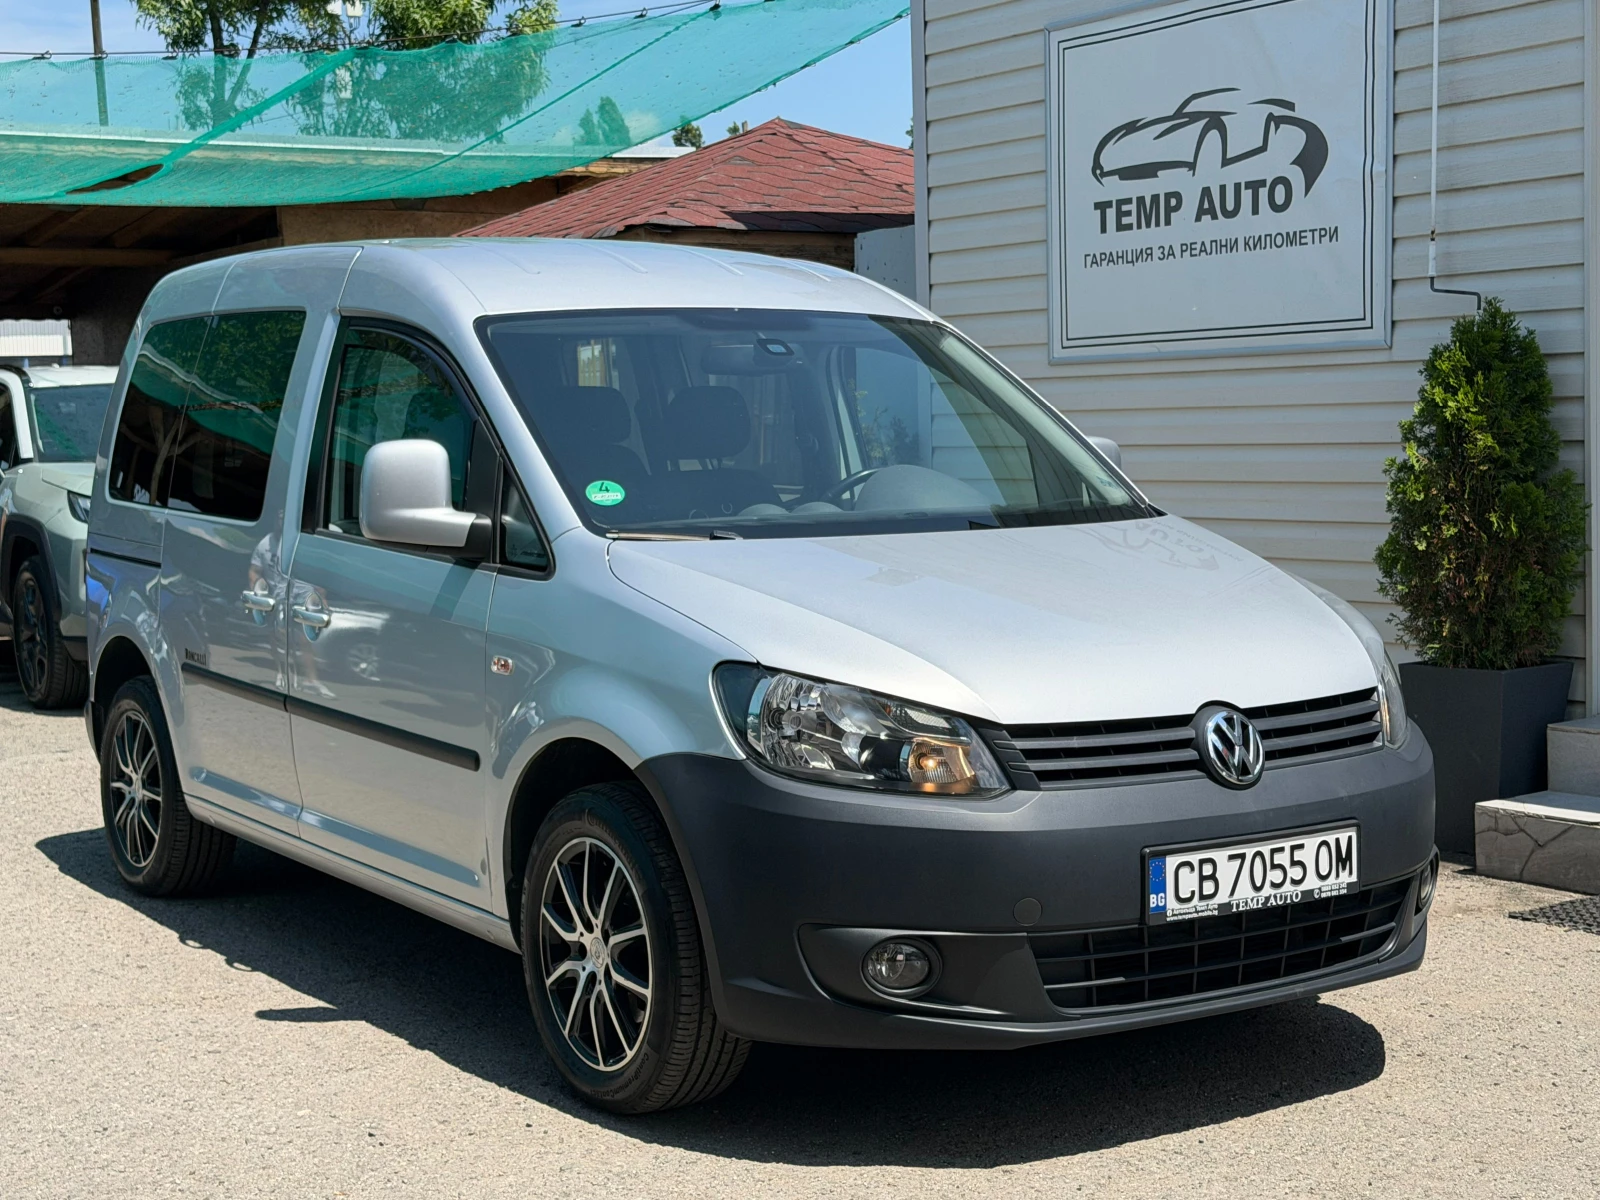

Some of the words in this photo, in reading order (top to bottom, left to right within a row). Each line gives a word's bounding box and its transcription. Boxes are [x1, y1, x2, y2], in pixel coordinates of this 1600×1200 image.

[1094, 190, 1183, 234] TEMP
[1194, 175, 1293, 223] AUTO
[1084, 246, 1154, 269] ГАРАНЦИЯ
[1157, 244, 1176, 261] ЗА
[1180, 237, 1239, 258] РЕАЛНИ
[1243, 225, 1339, 251] КИЛОМЕТРИ
[599, 481, 610, 493] 4
[1174, 859, 1220, 904] CB
[1228, 843, 1308, 898] 7055
[1314, 835, 1353, 882] OM
[1150, 893, 1165, 908] BG
[1231, 896, 1265, 913] TEMP
[1267, 891, 1301, 907] AUTO
